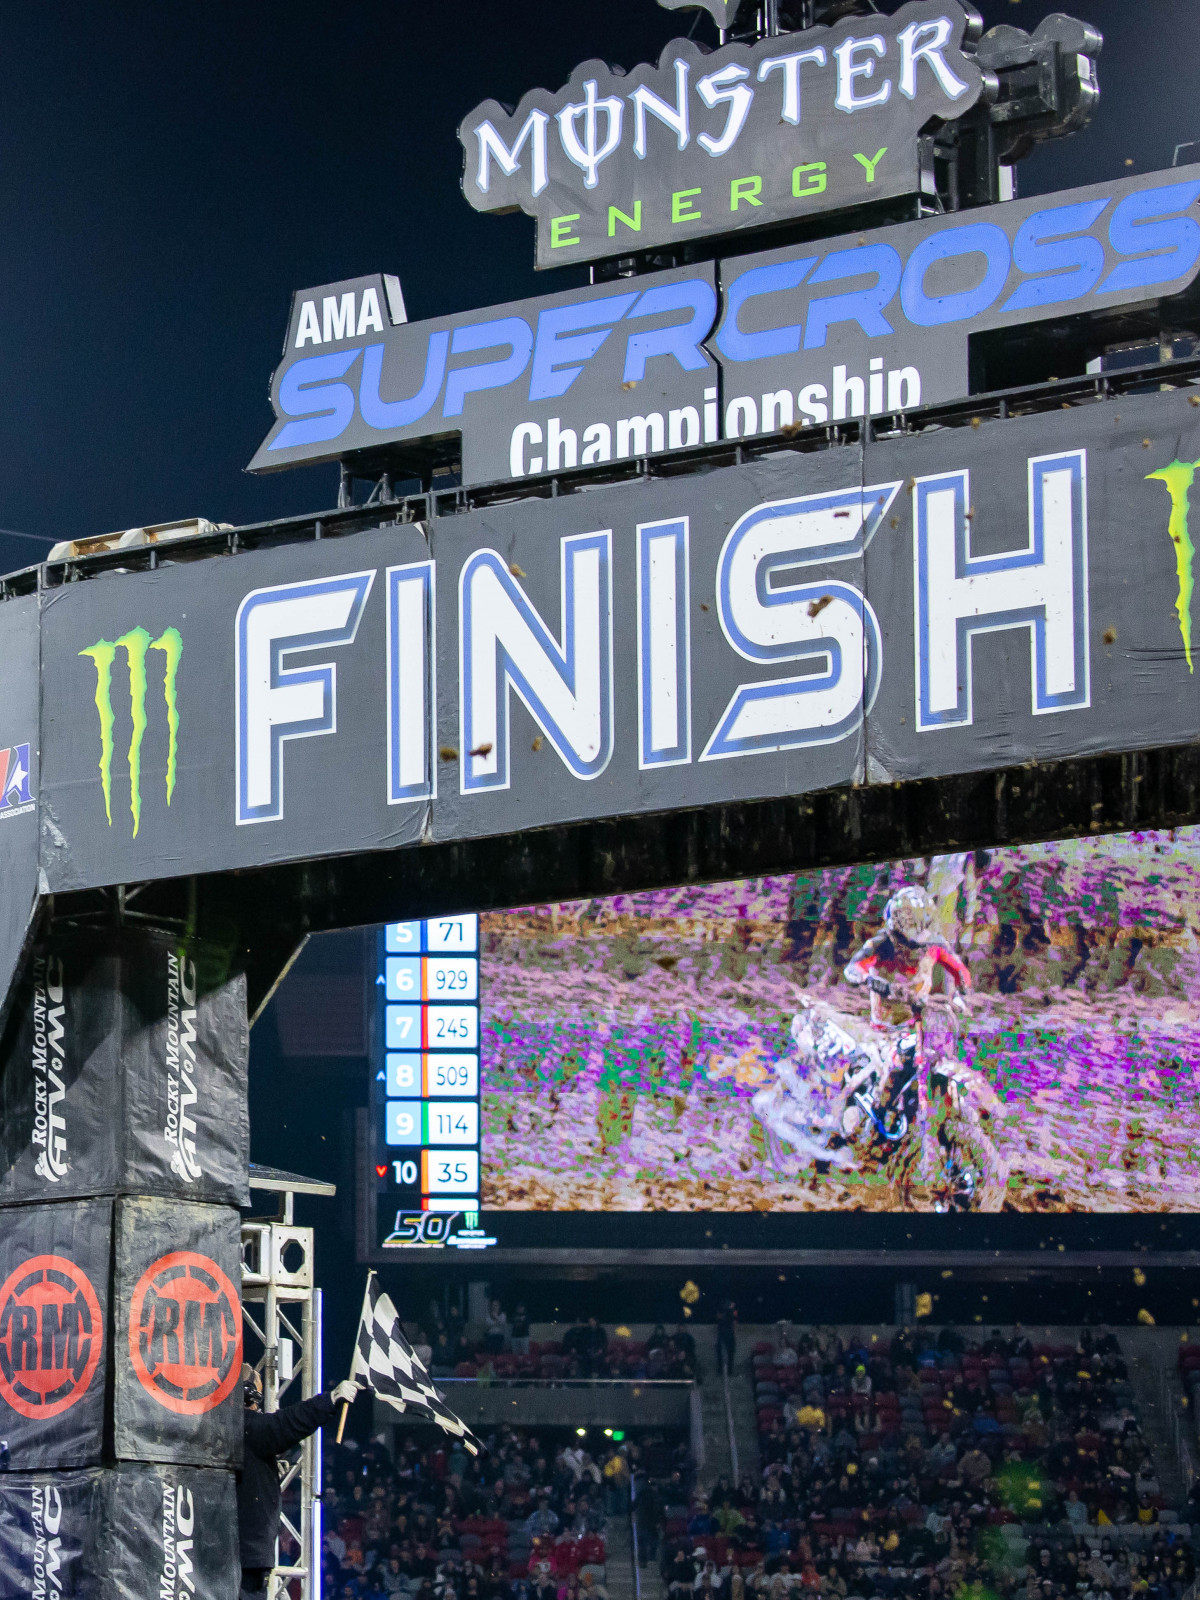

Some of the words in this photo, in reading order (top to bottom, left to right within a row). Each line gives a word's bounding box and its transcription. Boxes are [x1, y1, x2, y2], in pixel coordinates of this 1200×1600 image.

[475, 16, 968, 197] MONSTER
[550, 148, 888, 249] ENERGY
[267, 179, 1200, 451] SUPERCROSS
[295, 287, 384, 349] AMA
[509, 357, 921, 478] Championship
[235, 448, 1091, 826] FINISH
[395, 922, 413, 943] 5
[439, 922, 463, 942] 71
[32, 955, 48, 1073] MOUNTAIN
[166, 951, 180, 1073] MOUNTAIN
[395, 968, 414, 992] 6
[436, 970, 469, 990] 929
[395, 1016, 414, 1040] 7
[436, 1018, 469, 1038] 245
[32, 1073, 48, 1148] ROCKY
[164, 1073, 180, 1148] ROCKY
[395, 1064, 414, 1088] 8
[436, 1066, 469, 1086] 509
[395, 1113, 414, 1137] 9
[436, 1115, 469, 1135] 114
[392, 1160, 418, 1185] 10
[437, 1162, 468, 1184] 35
[384, 1209, 460, 1244] 50
[31, 1485, 46, 1600] MOUNTAIN
[160, 1481, 176, 1600] MOUNTAIN
